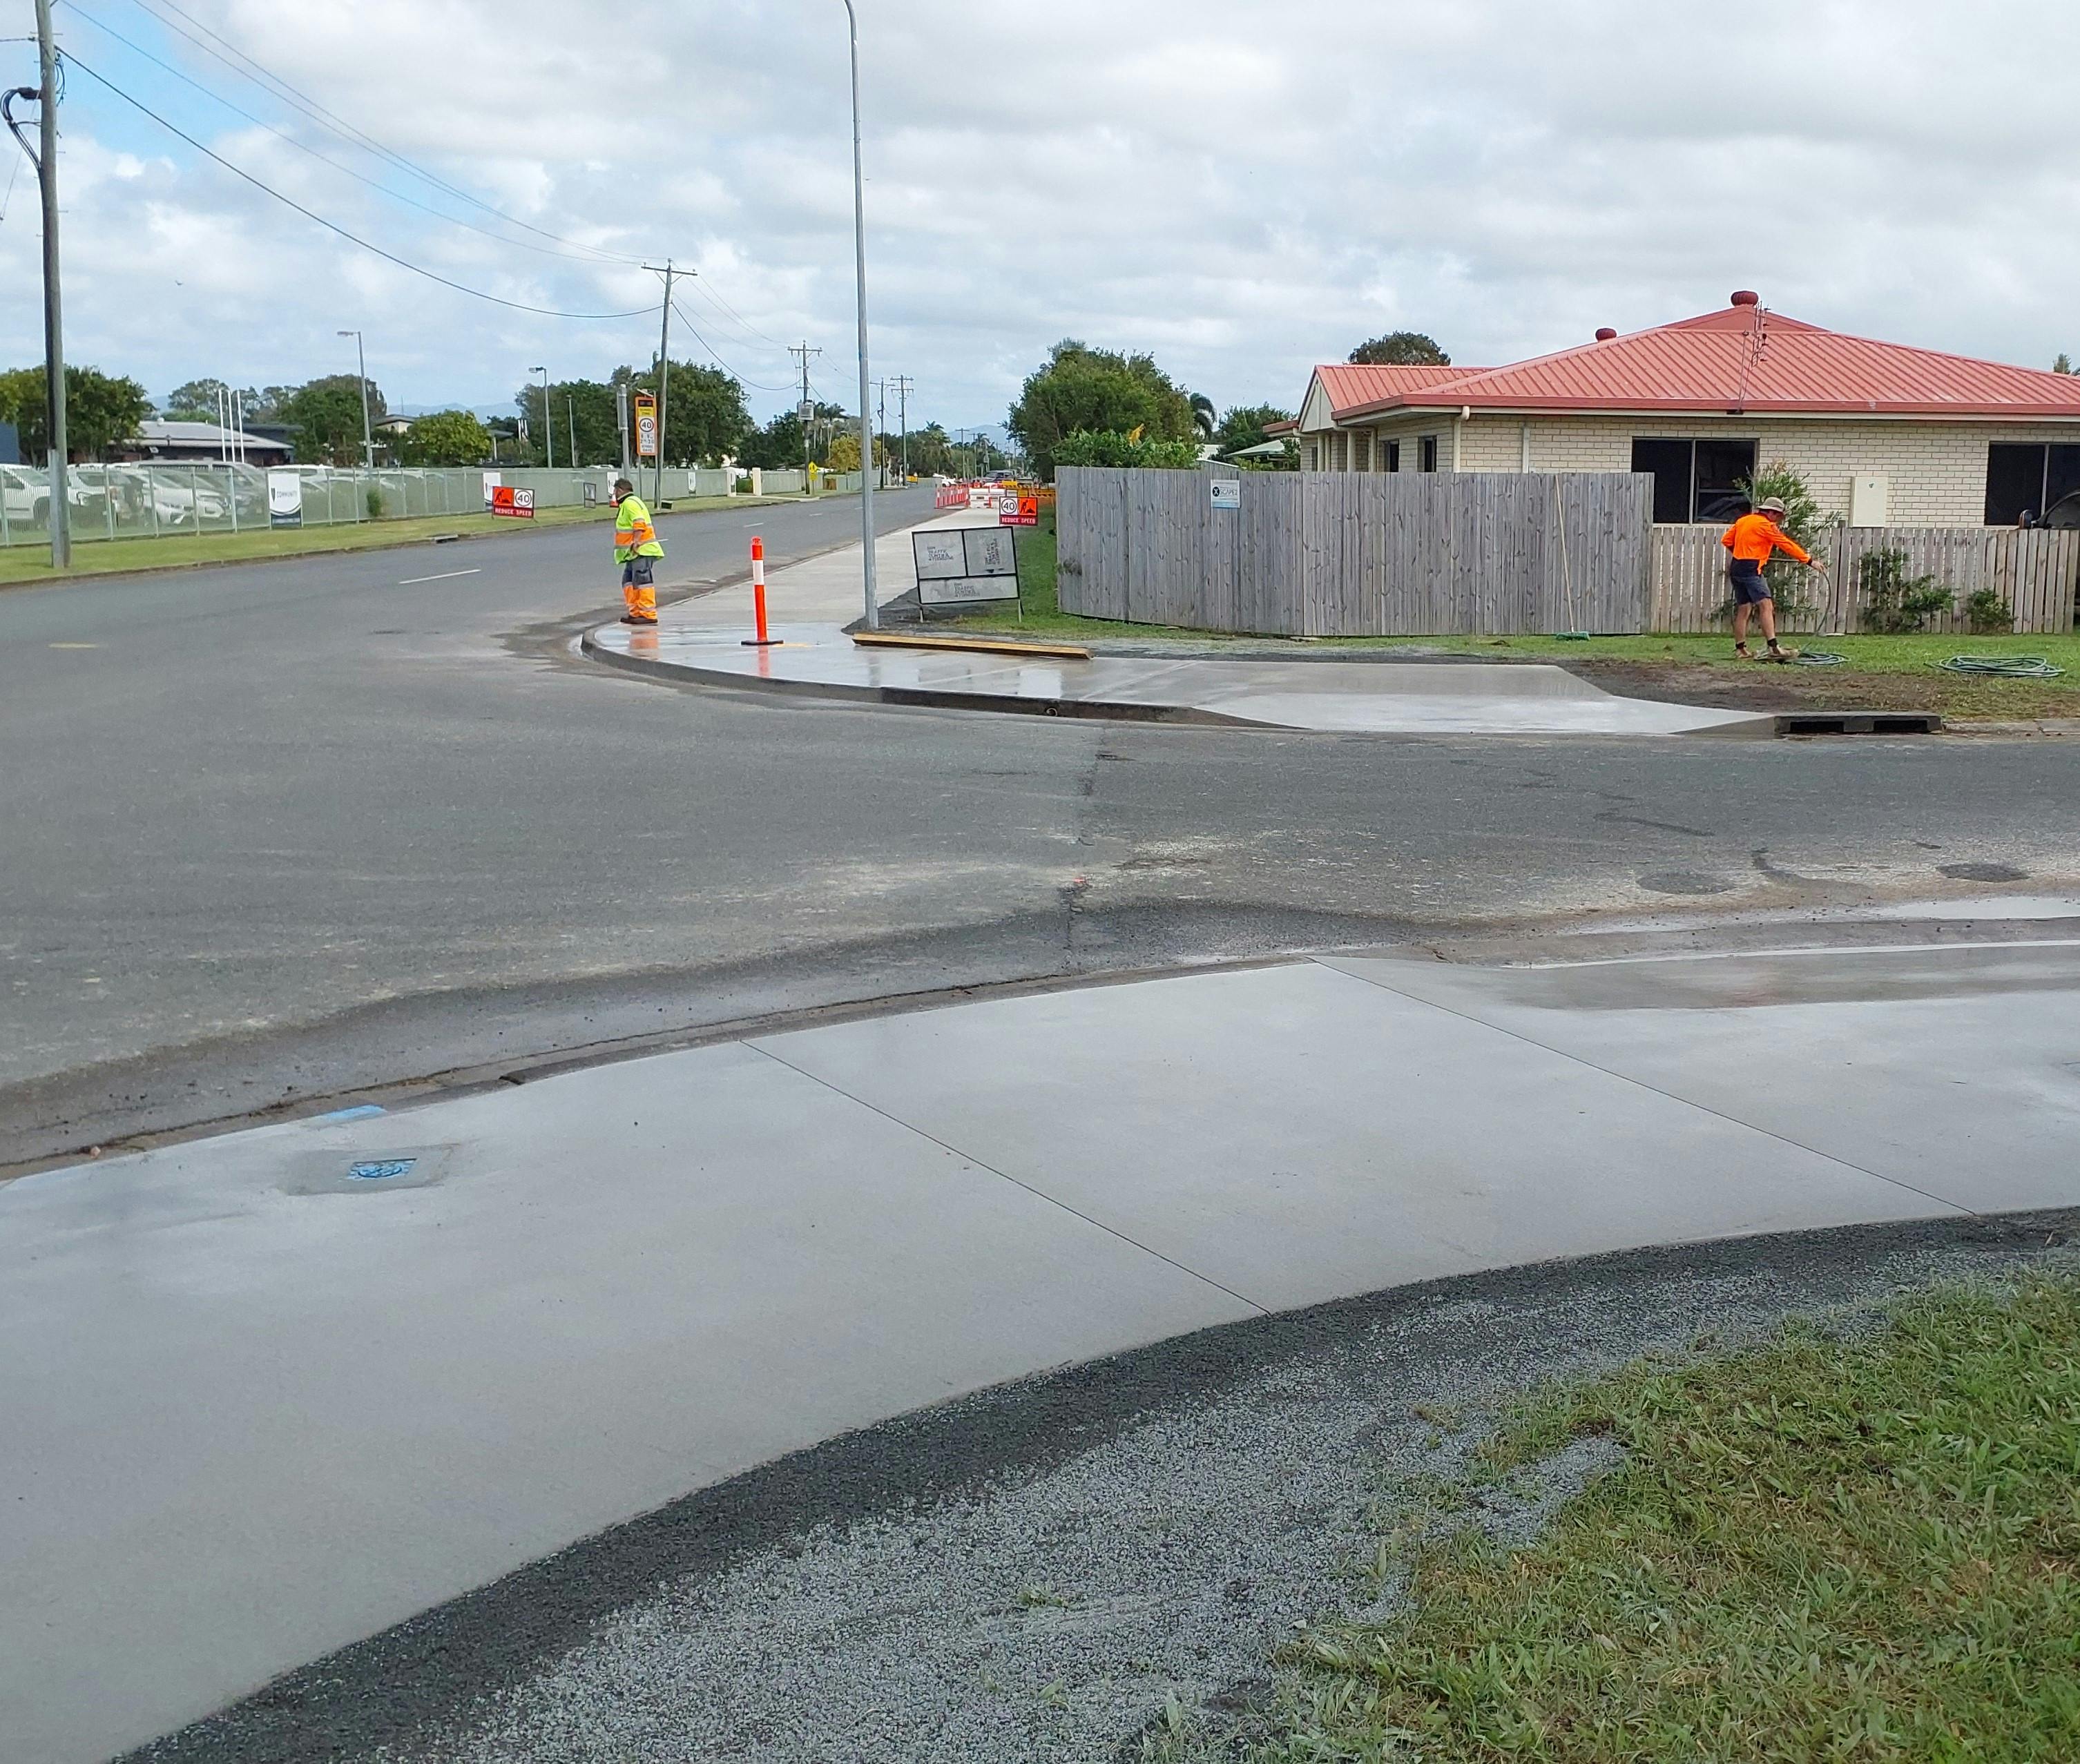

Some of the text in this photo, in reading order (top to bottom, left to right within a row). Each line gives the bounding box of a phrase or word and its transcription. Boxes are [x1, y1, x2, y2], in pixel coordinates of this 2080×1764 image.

[517, 494, 530, 503] 40
[1003, 502, 1015, 510] 40
[516, 509, 532, 517] SPEED
